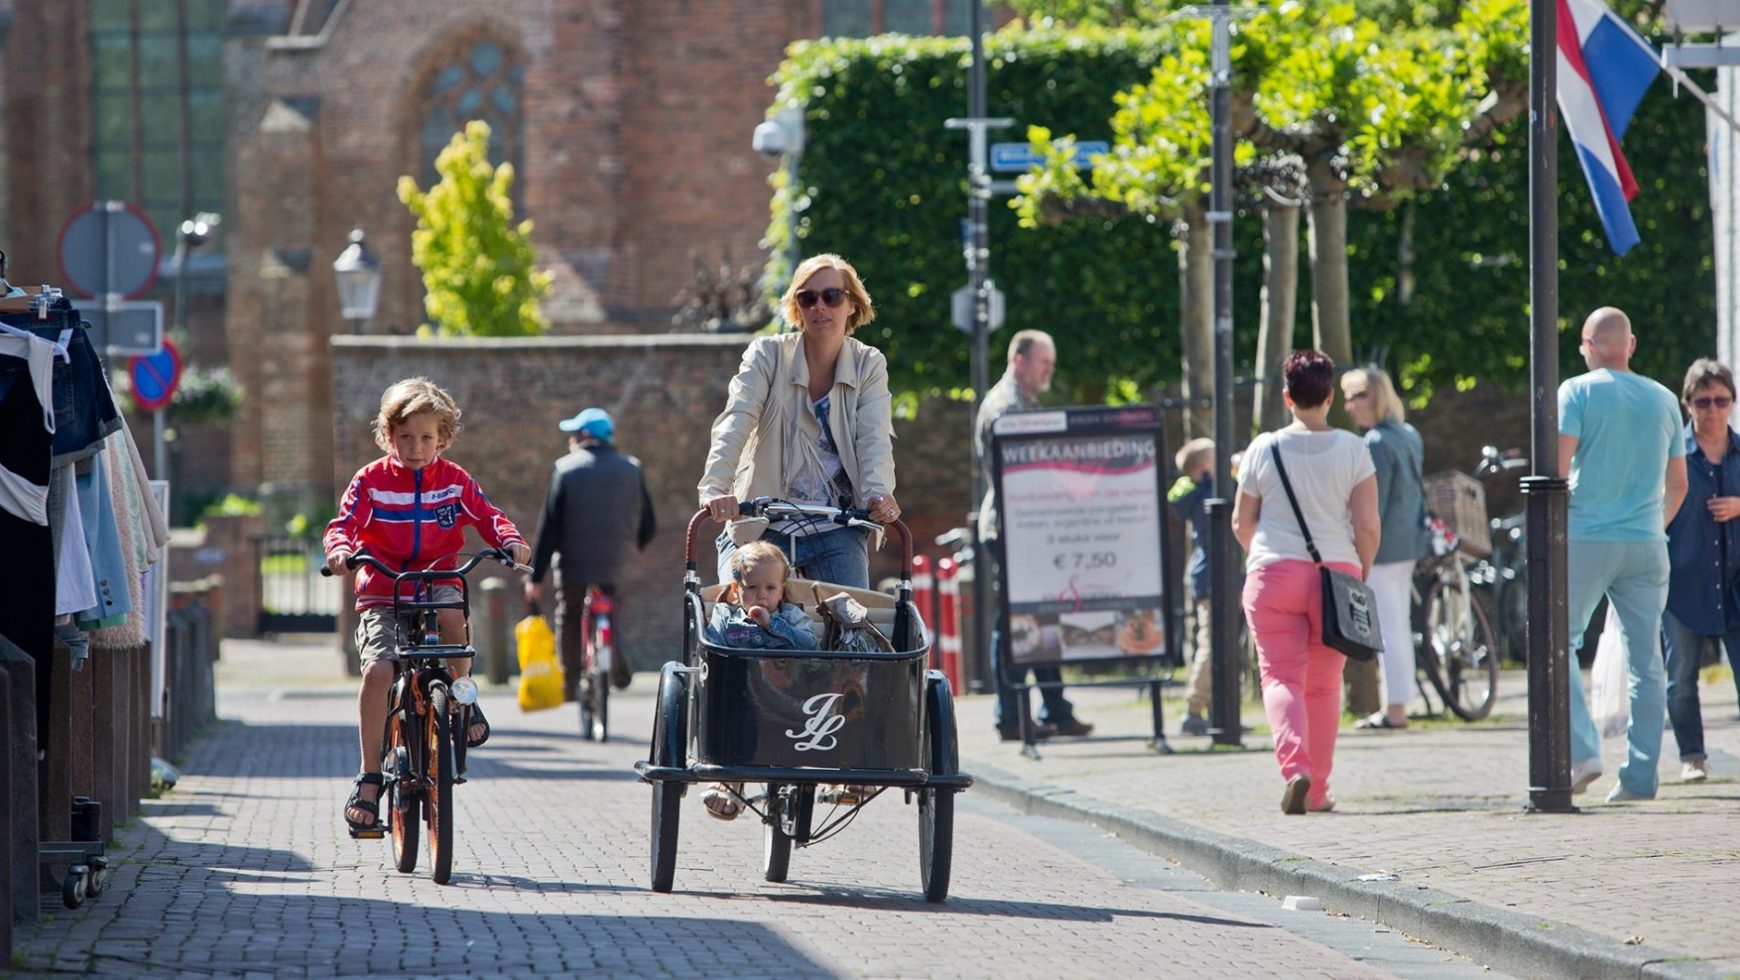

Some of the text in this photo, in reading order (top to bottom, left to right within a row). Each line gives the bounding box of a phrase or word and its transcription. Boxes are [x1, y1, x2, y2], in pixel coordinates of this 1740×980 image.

[1002, 438, 1156, 464] WEEKAANBIEDING
[1058, 533, 1090, 545] stuks
[1093, 533, 1121, 543] voor
[1054, 551, 1118, 570] € 7,50
